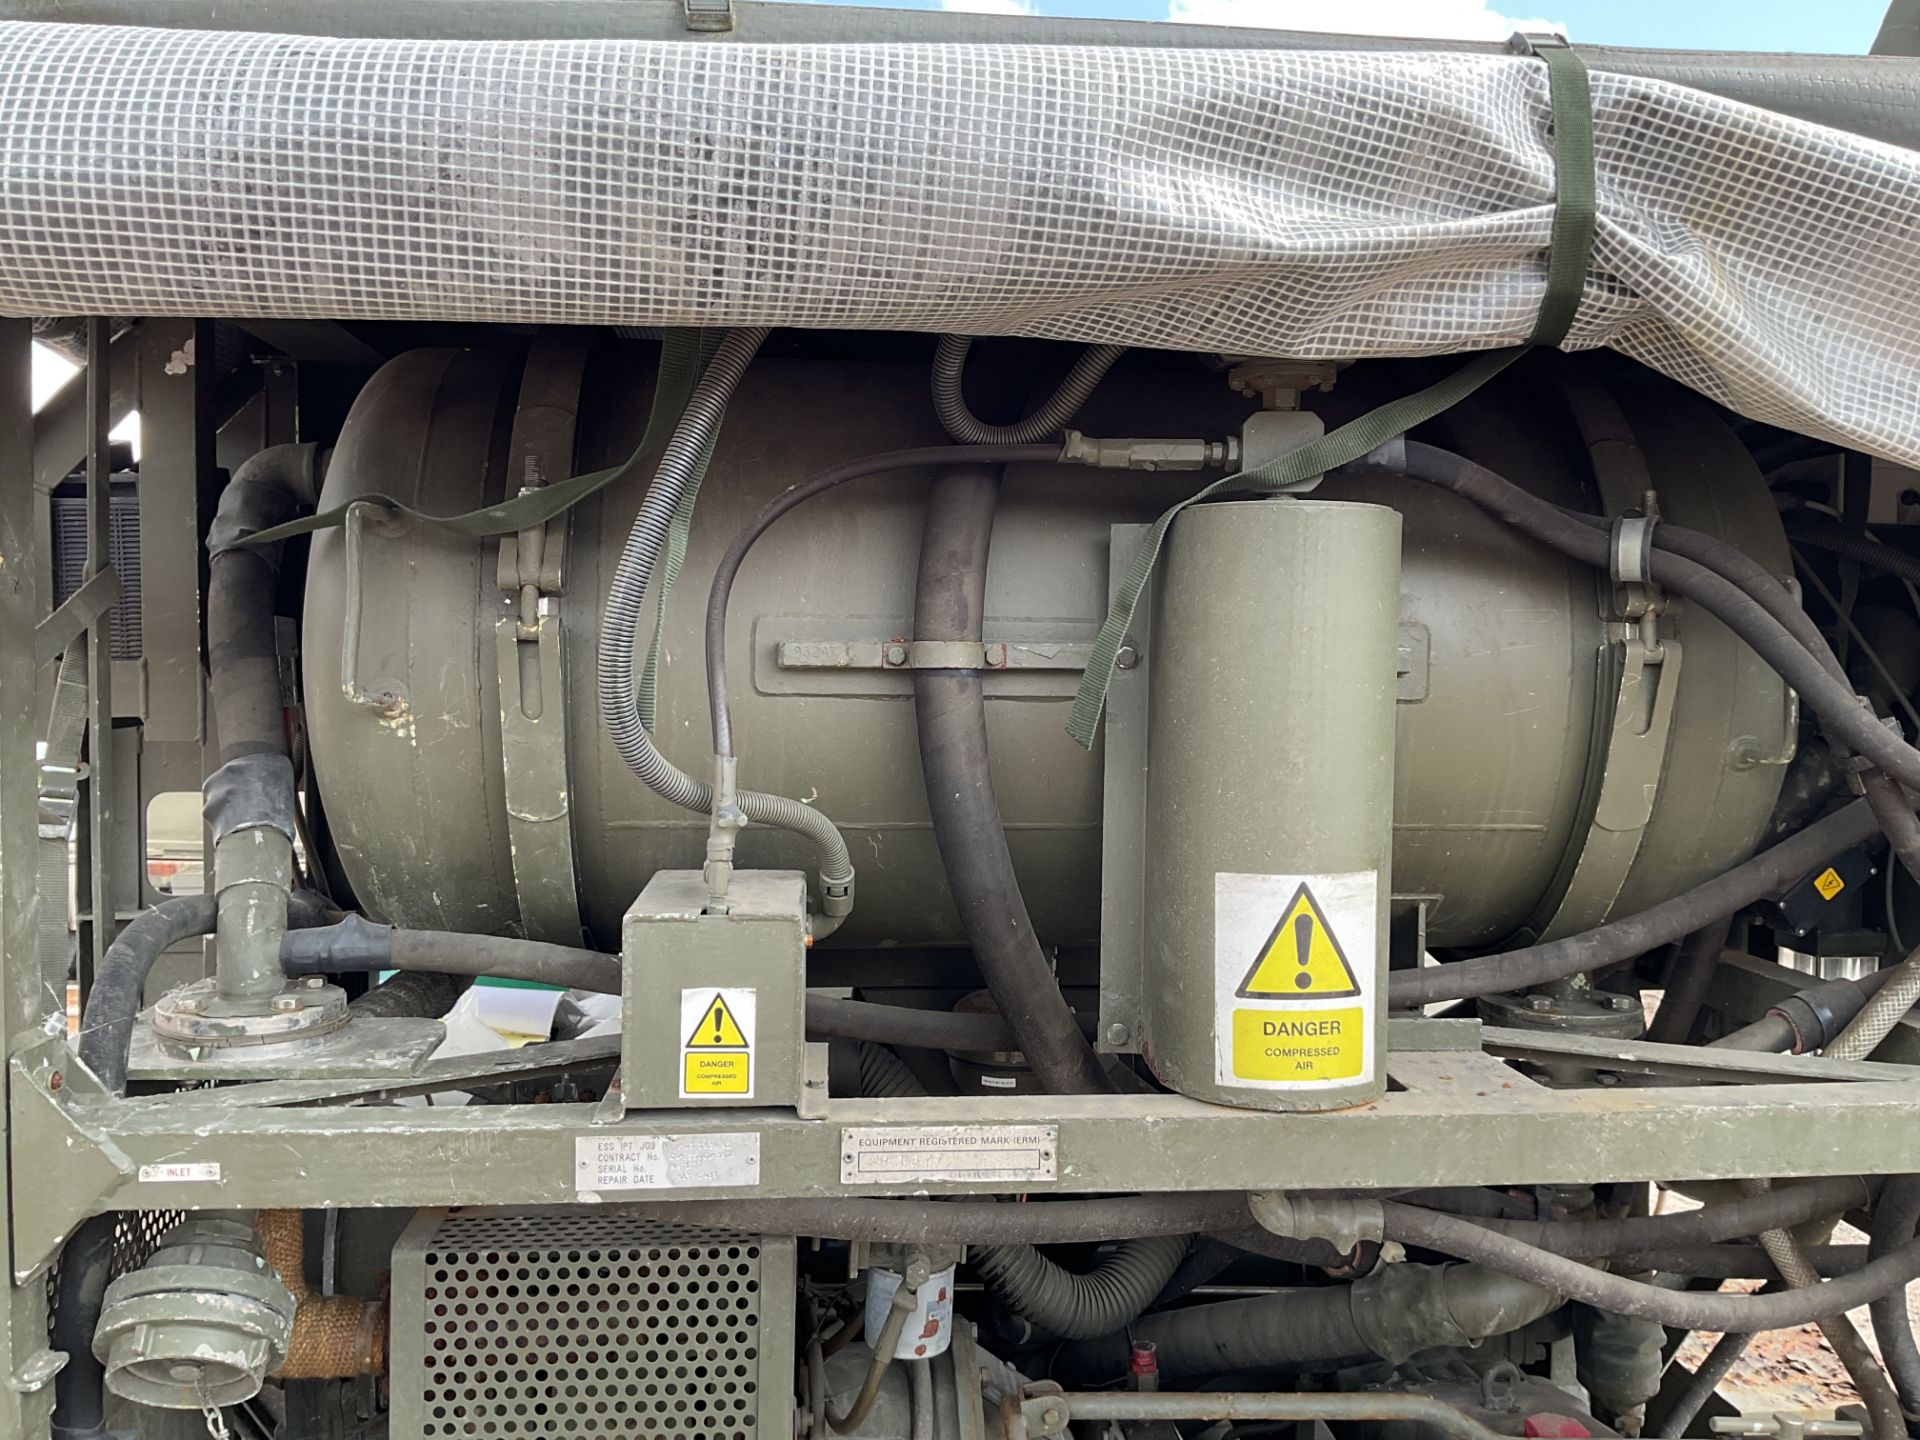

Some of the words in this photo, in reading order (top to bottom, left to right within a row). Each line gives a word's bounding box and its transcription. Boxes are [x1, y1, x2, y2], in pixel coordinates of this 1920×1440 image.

[1263, 1020, 1341, 1036] DANGER
[1265, 1046, 1340, 1057] COMPRESSED
[1295, 1061, 1313, 1070] AIR
[598, 1142, 614, 1151] ESS
[620, 1142, 632, 1151] IPT
[640, 1141, 655, 1150] JOB
[859, 1138, 914, 1147] EQUIPMENT
[920, 1137, 976, 1146] REGISTERED
[981, 1137, 1009, 1145] MARK
[1013, 1136, 1040, 1145] (ERM)
[598, 1153, 640, 1162] CONTRACT
[647, 1152, 660, 1161] No.
[166, 1168, 191, 1177] INLET
[598, 1165, 627, 1174] SERIAL
[598, 1175, 627, 1184] REPAIR
[634, 1174, 654, 1184] DATE
